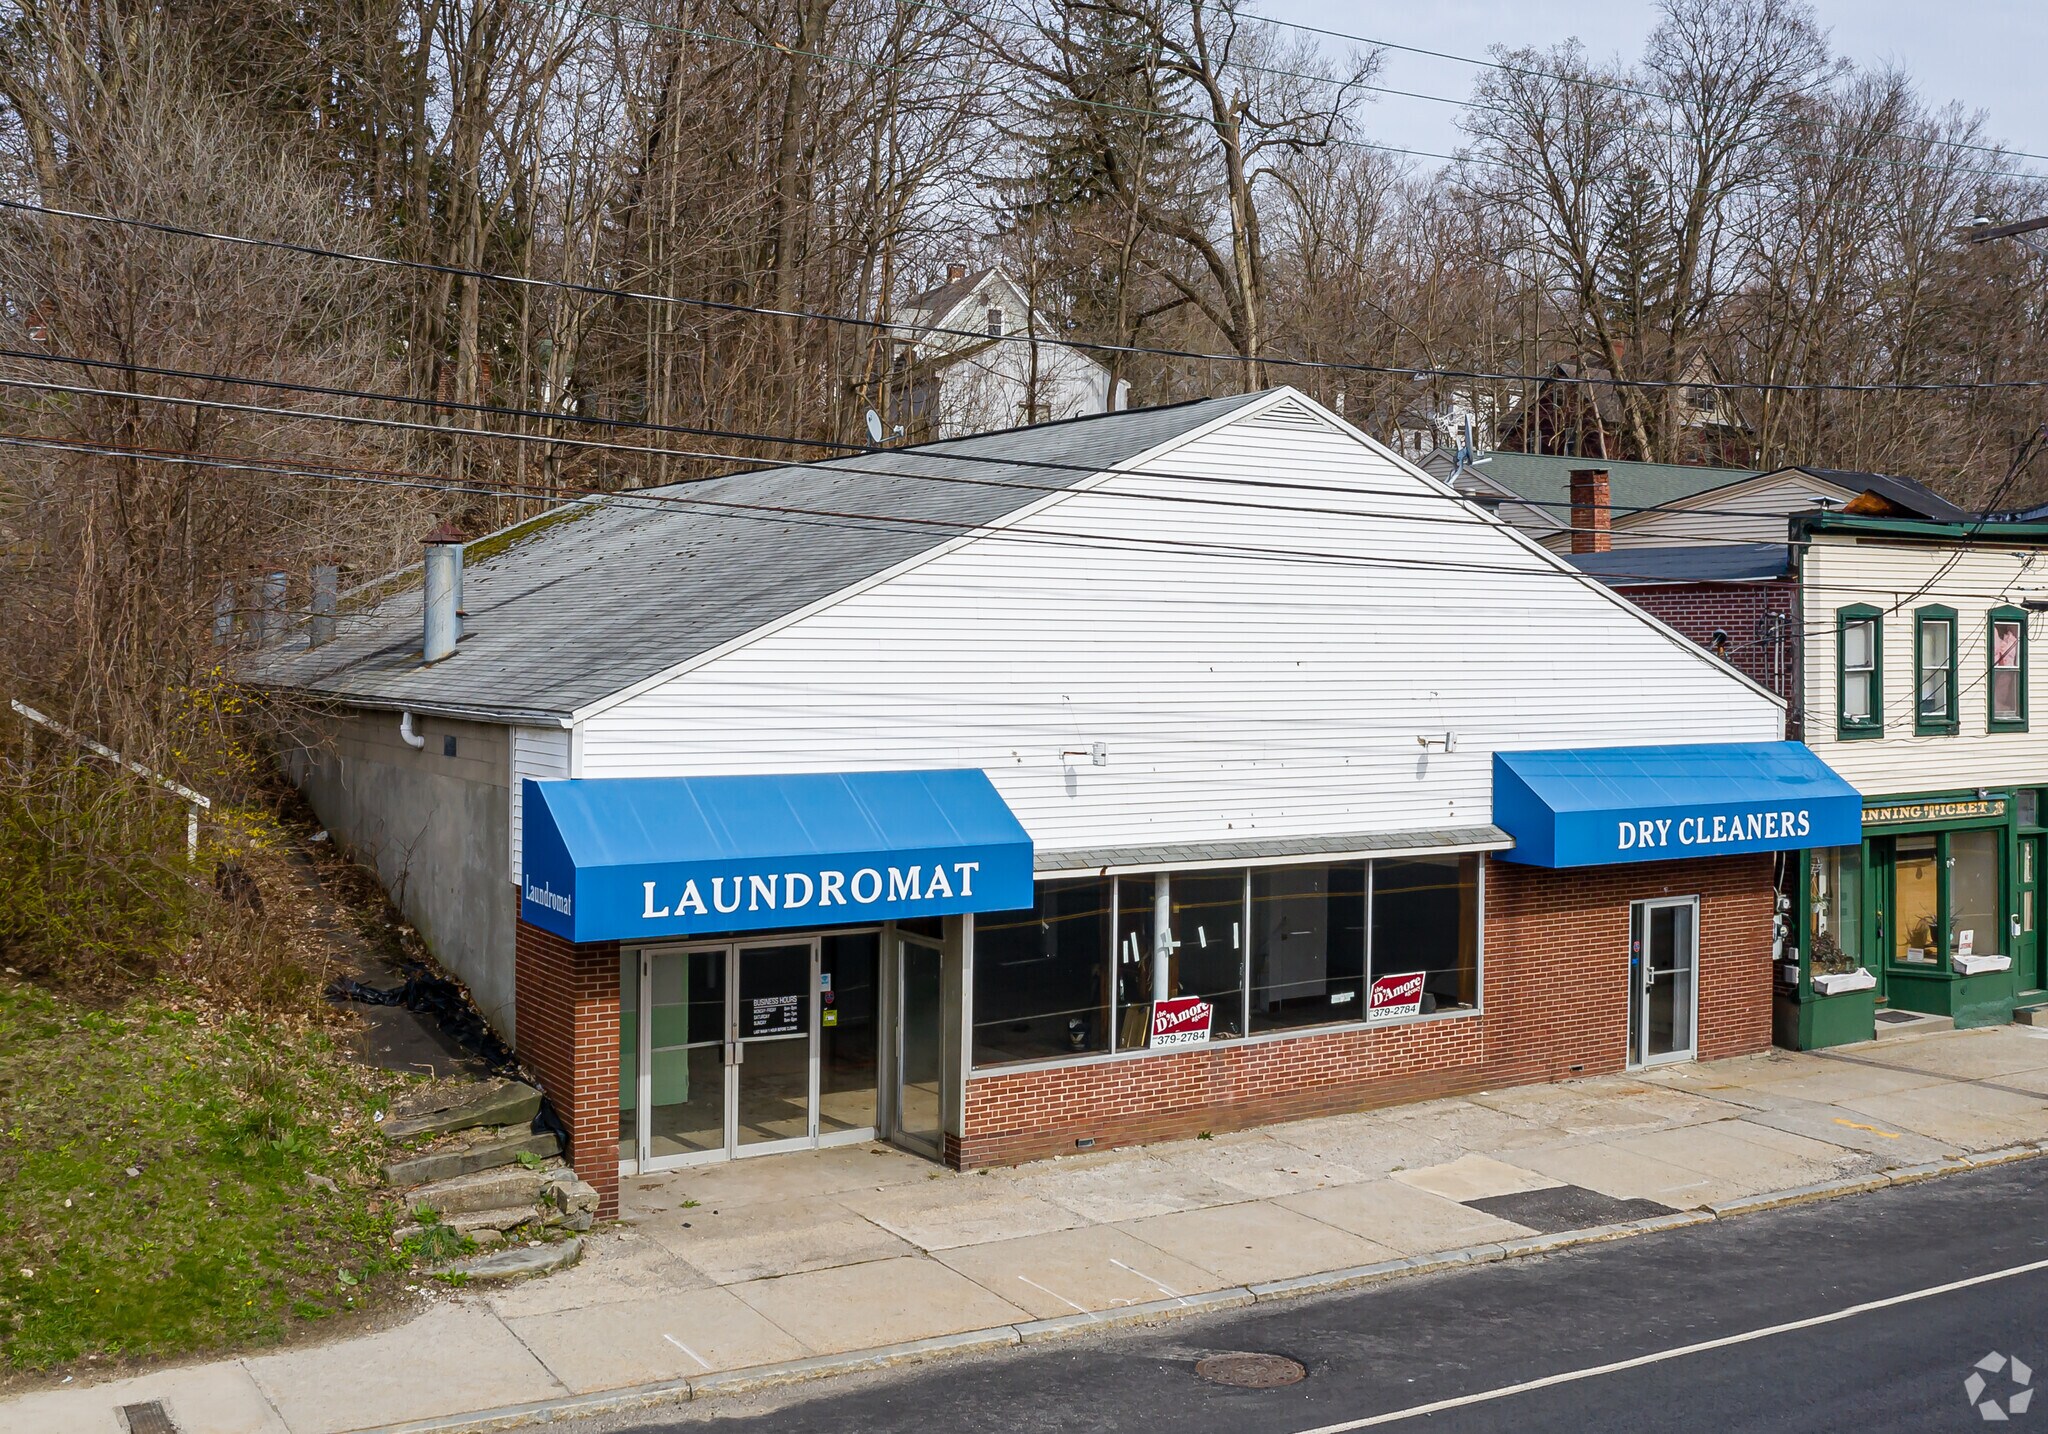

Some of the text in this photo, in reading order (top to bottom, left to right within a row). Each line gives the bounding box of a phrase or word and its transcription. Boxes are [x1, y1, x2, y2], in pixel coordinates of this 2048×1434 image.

[1923, 801, 1988, 818] TICKET
[1618, 810, 1810, 850] DRY CLEANERS
[526, 874, 571, 916] Laundromat
[642, 862, 980, 919] LAUNDROMAT
[1373, 977, 1421, 1006] D'Amore
[1374, 985, 1384, 993] the
[753, 995, 798, 1006] BUSINESS HOURS
[1155, 1002, 1209, 1033] D'Amore
[1156, 1010, 1167, 1018] the
[1373, 1005, 1416, 1017] 379-2784
[1157, 1031, 1205, 1045] 379-2784
